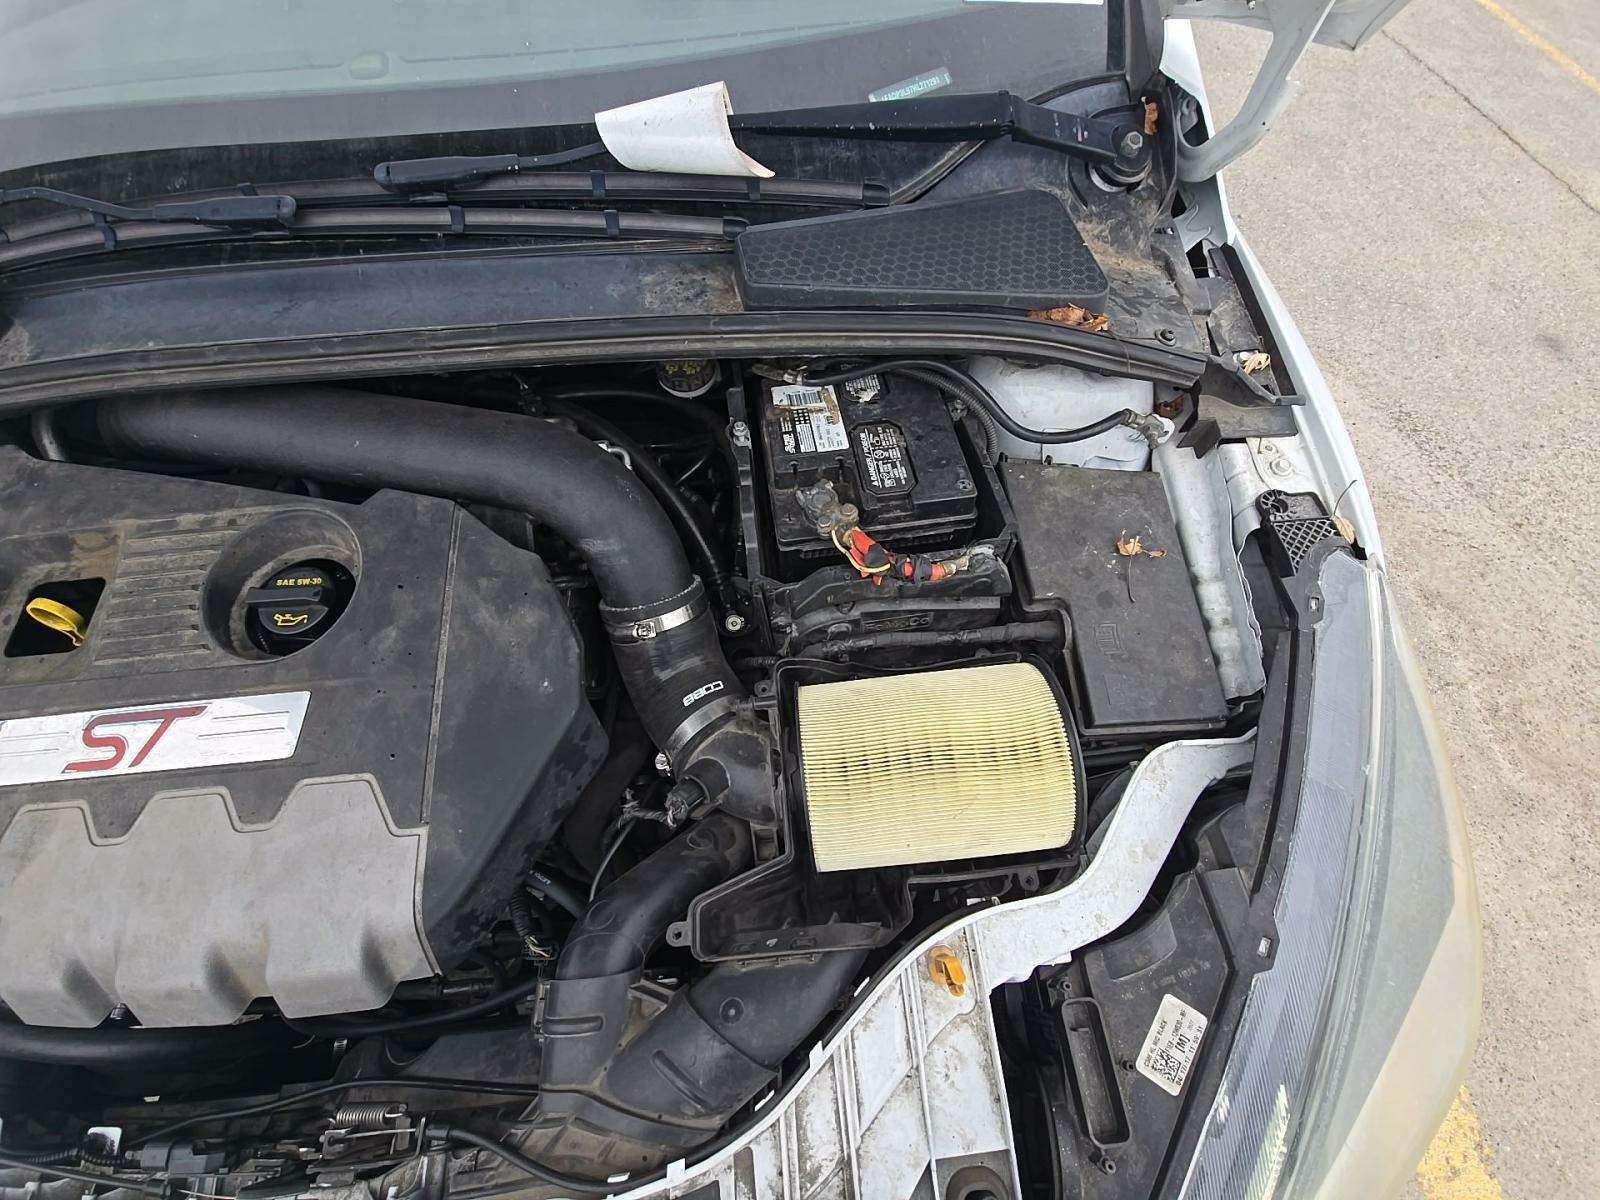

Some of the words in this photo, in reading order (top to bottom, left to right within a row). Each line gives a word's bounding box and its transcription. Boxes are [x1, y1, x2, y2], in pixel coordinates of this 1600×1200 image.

[860, 433, 871, 452] POISON
[866, 458, 877, 480] DANGER
[297, 577, 322, 586] 5W-30
[682, 680, 724, 707] COBB
[61, 703, 209, 773] ST
[1156, 1019, 1167, 1036] BLACK
[1174, 1033, 1190, 1053] [M]
